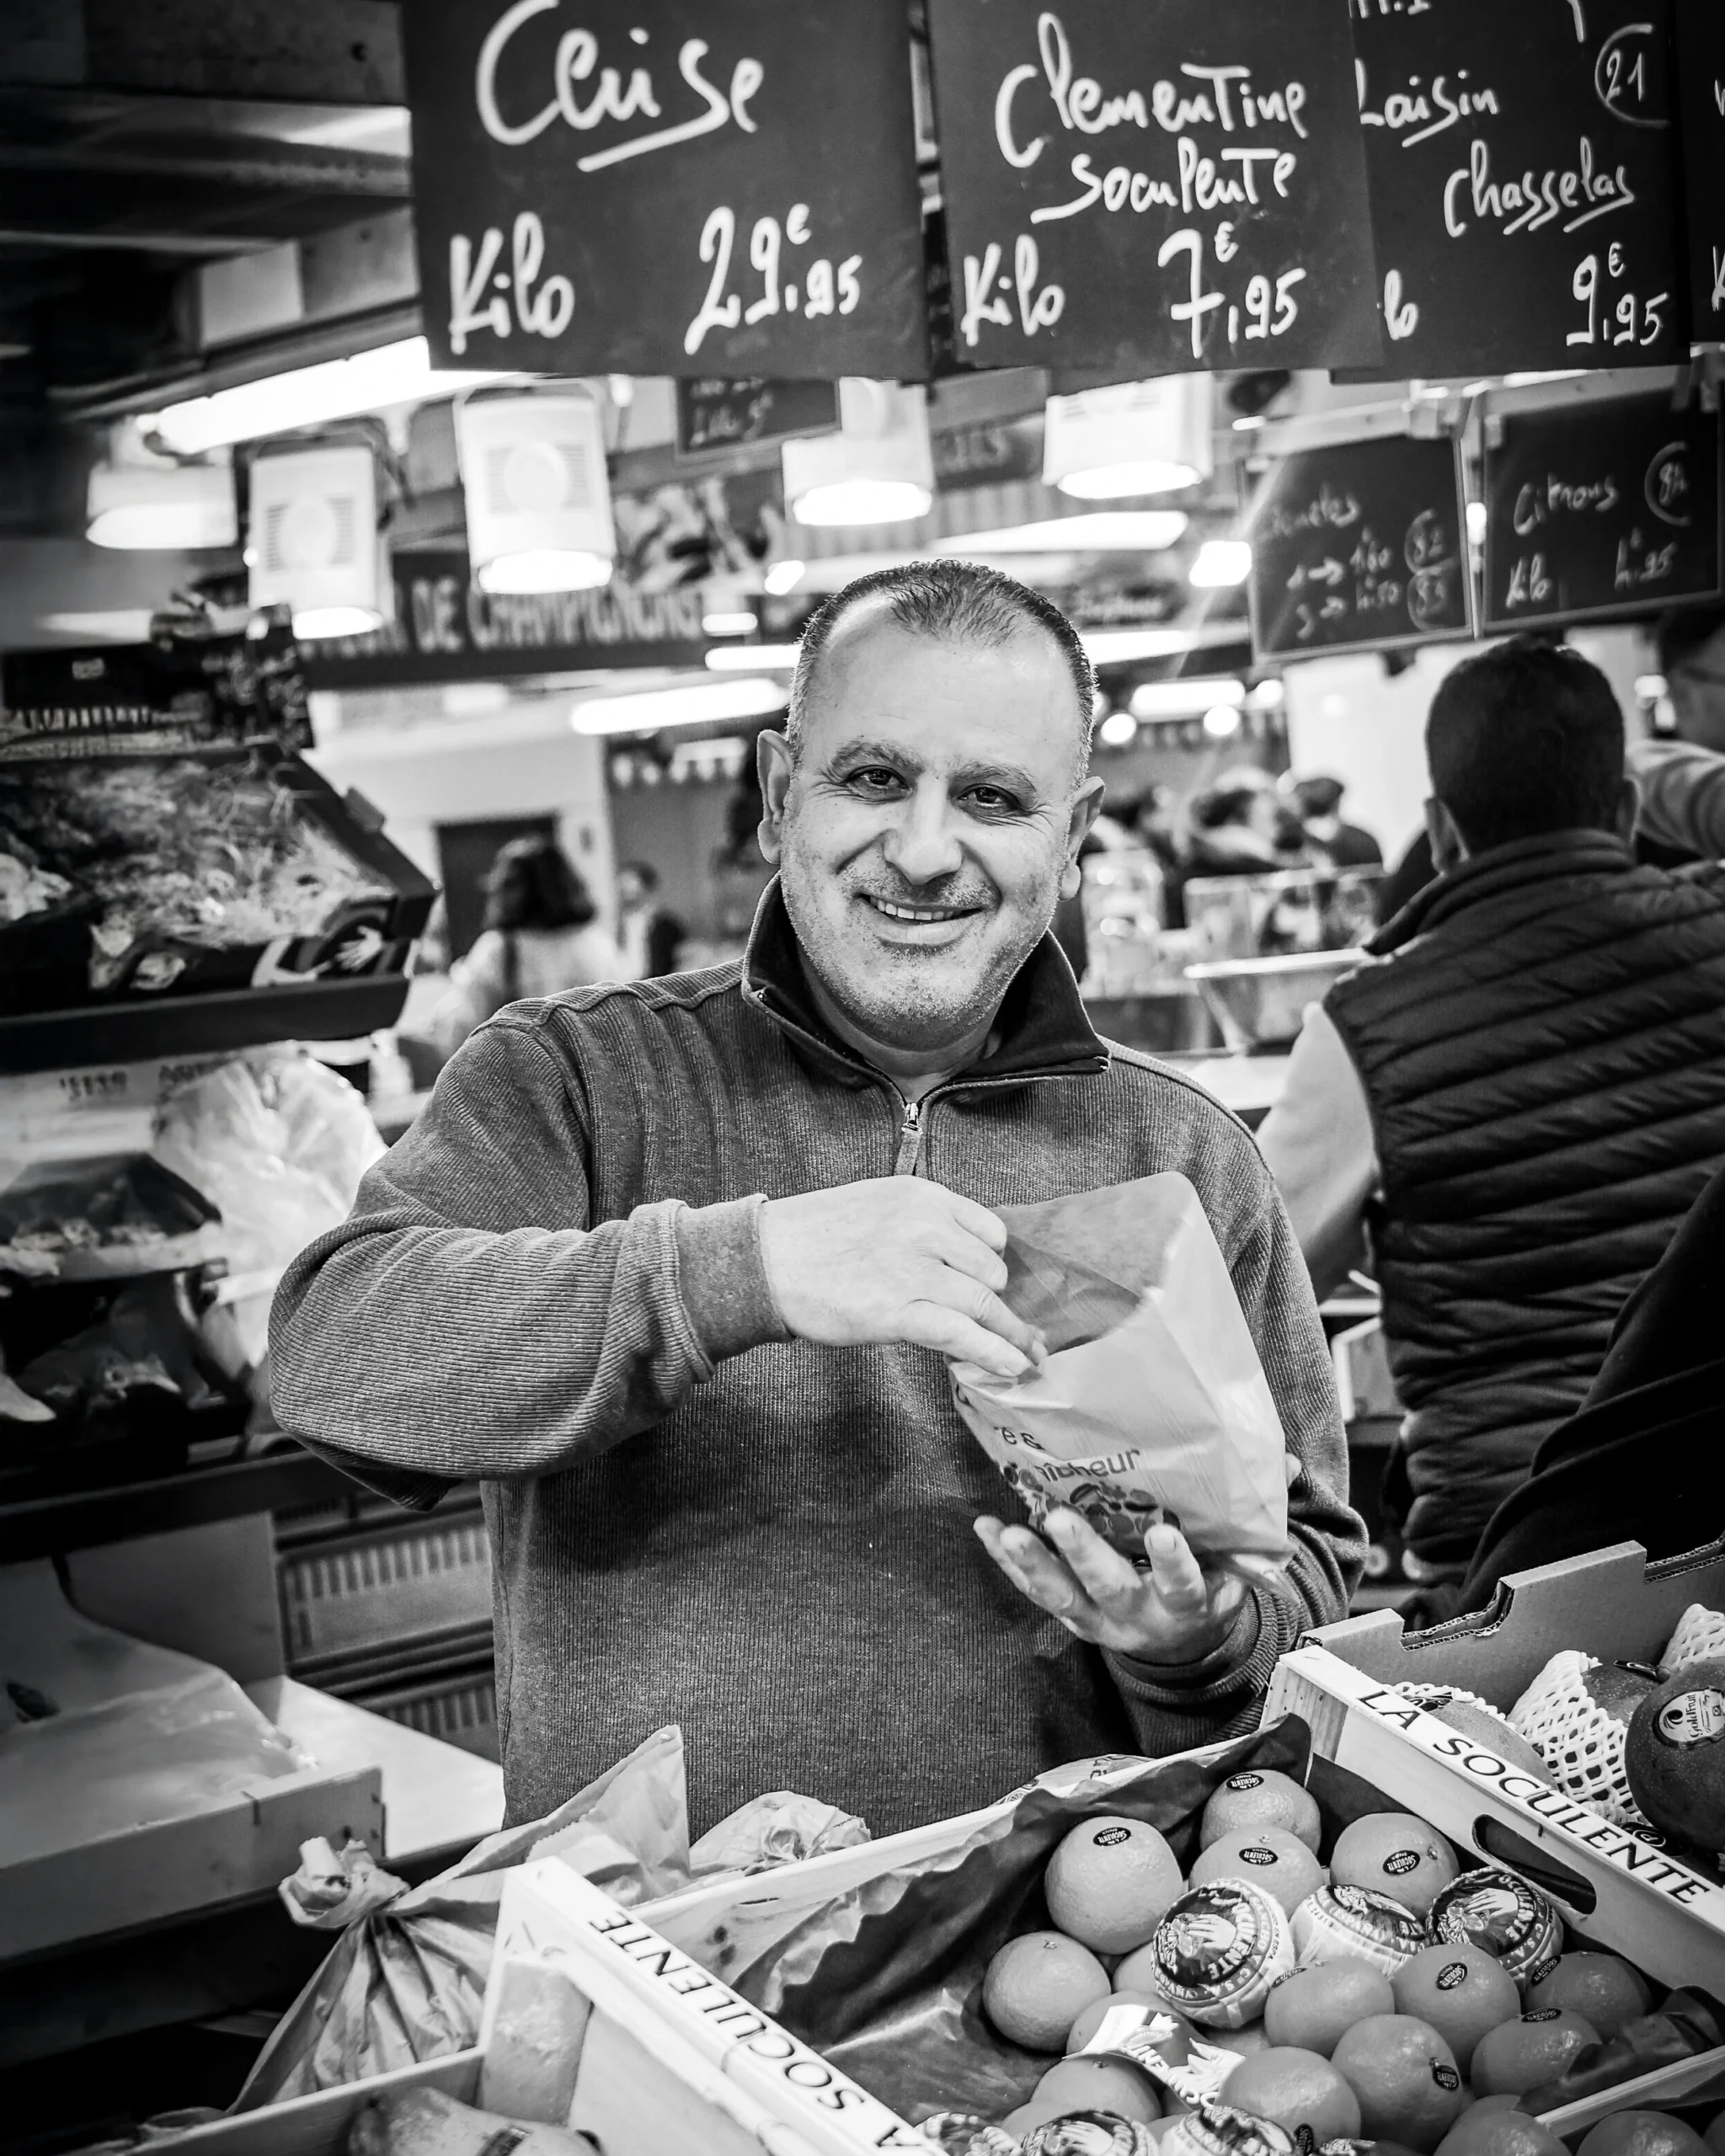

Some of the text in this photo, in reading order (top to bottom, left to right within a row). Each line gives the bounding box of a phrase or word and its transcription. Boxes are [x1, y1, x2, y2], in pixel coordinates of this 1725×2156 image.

[1443, 136, 1635, 238] Chasselas
[449, 211, 575, 355] Kilo
[961, 233, 1065, 346] Kilo
[1356, 1689, 1711, 1903] LA SOCULENTE
[1387, 1855, 1416, 1871] SOCULENTE
[590, 1910, 926, 2148] A SOCULENTE
